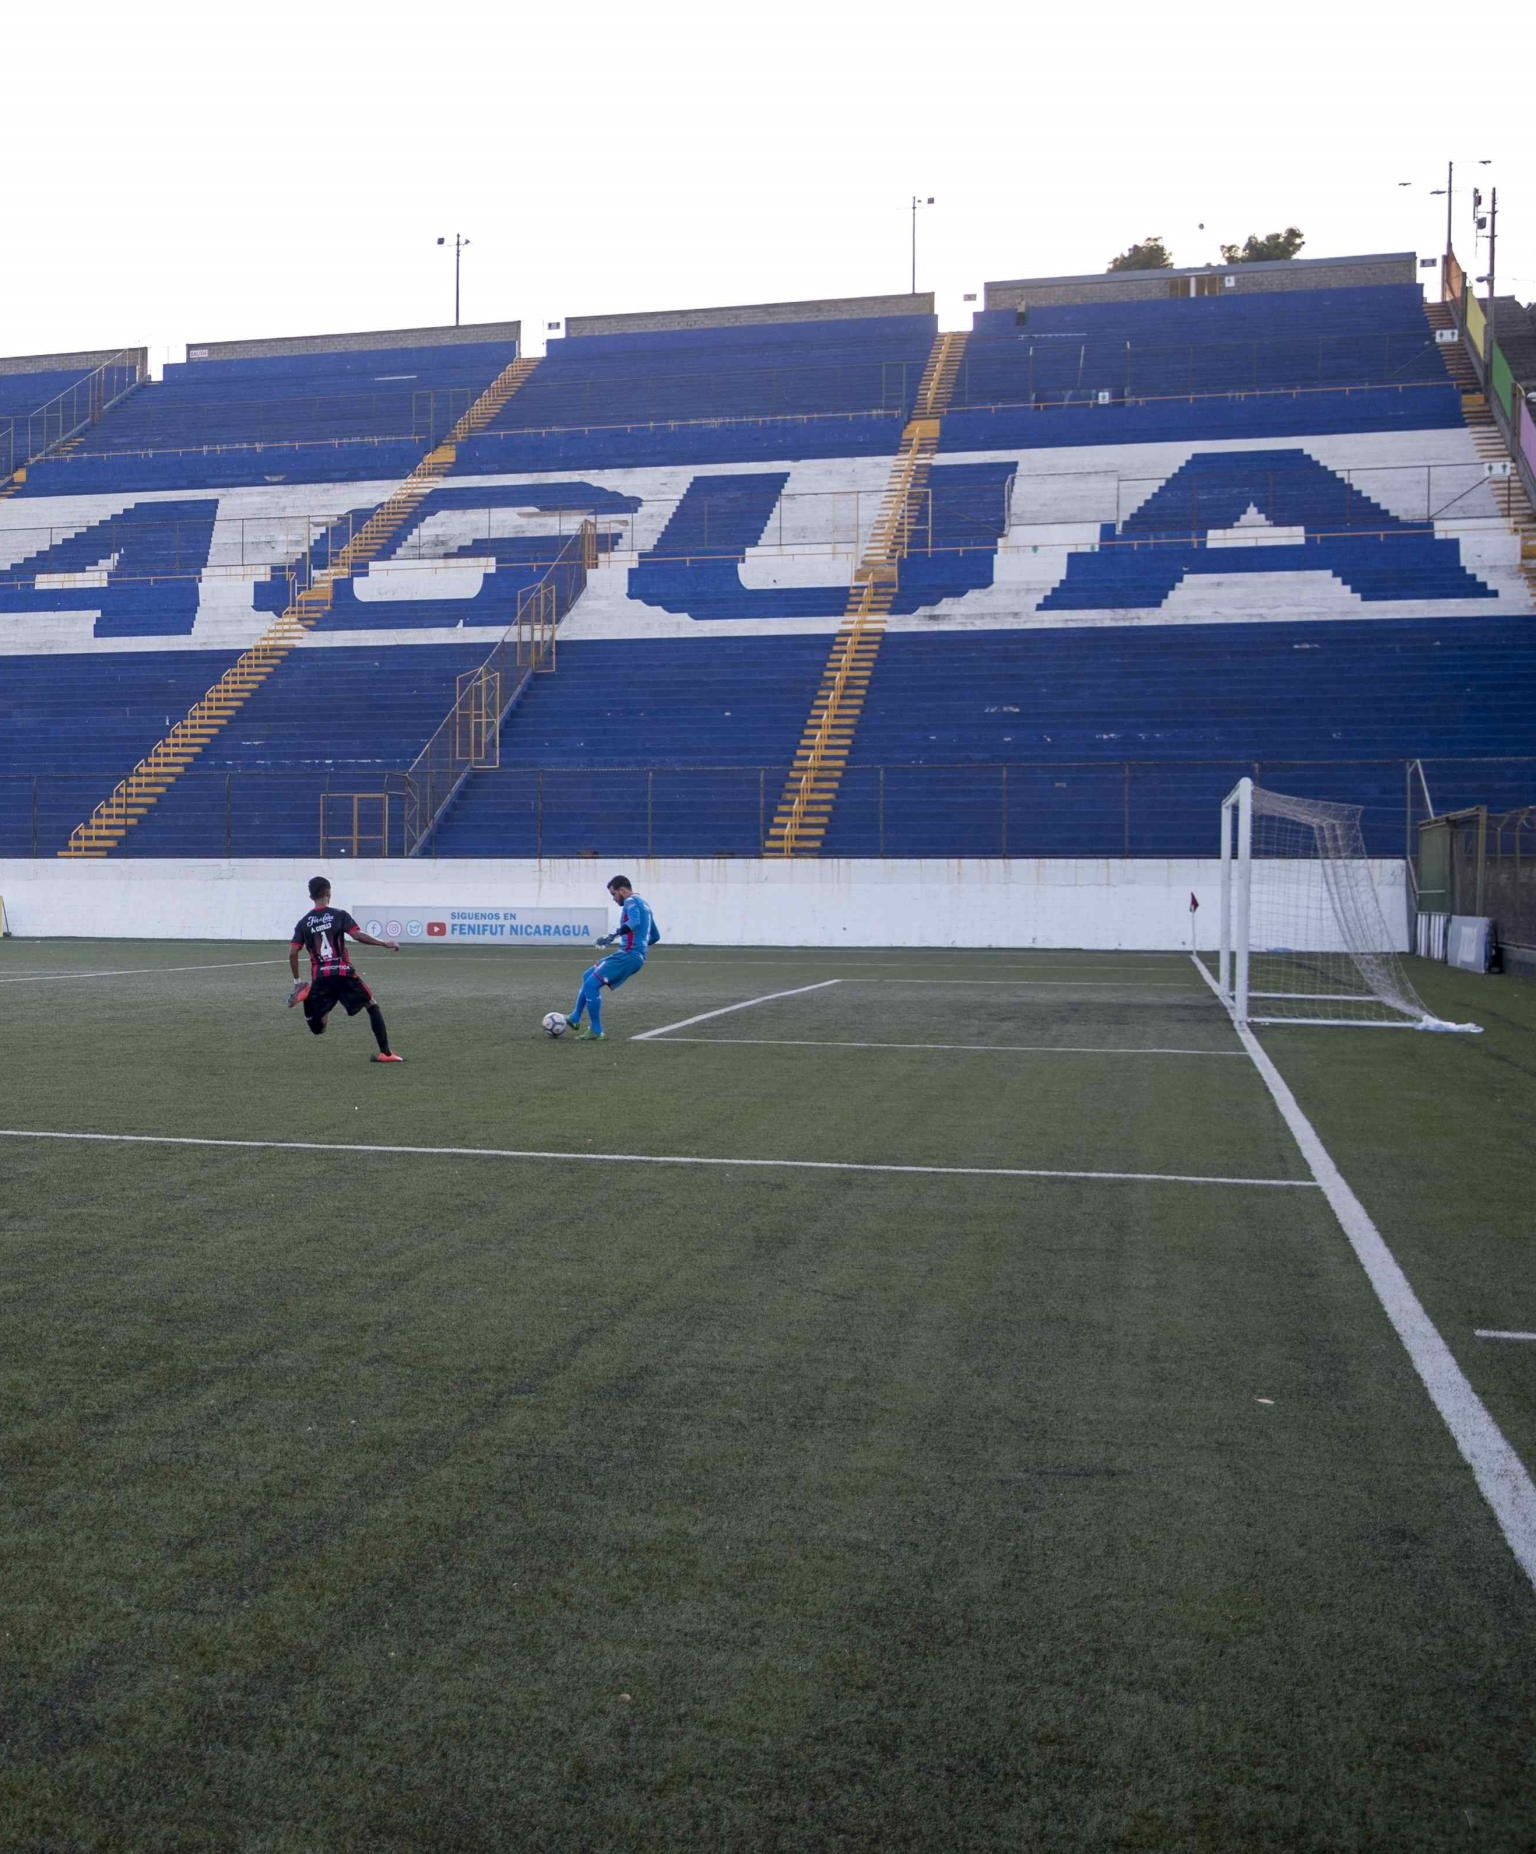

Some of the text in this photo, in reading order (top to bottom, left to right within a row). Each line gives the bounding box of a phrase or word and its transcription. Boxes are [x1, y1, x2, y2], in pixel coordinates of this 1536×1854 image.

[503, 912, 517, 920] EN
[450, 923, 590, 936] FENIFUT NICARAGUA
[320, 930, 333, 958] 4
